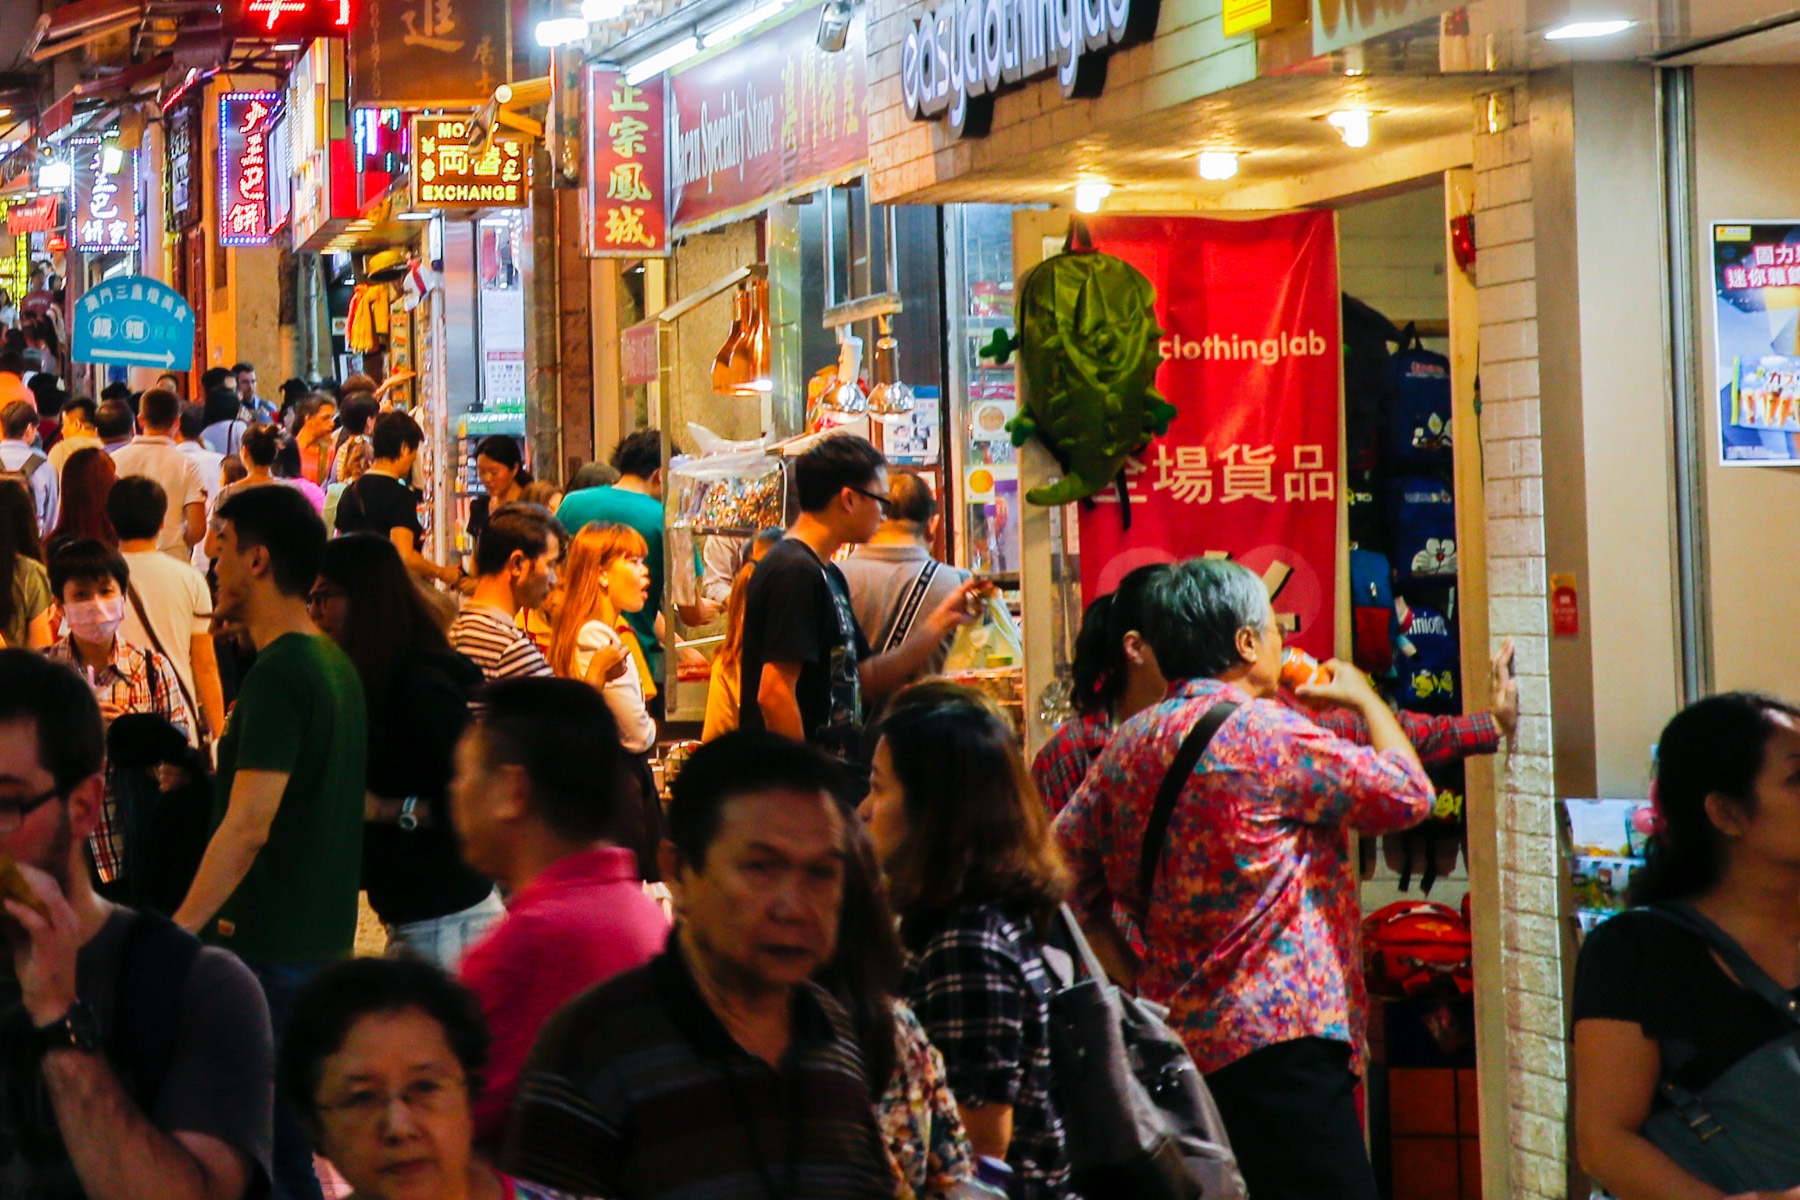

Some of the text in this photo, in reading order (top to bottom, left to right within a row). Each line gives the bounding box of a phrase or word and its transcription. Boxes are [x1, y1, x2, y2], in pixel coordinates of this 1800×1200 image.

[746, 81, 775, 160] Store
[421, 184, 518, 201] EXCHANGE
[605, 79, 656, 247] 正宗鳳城
